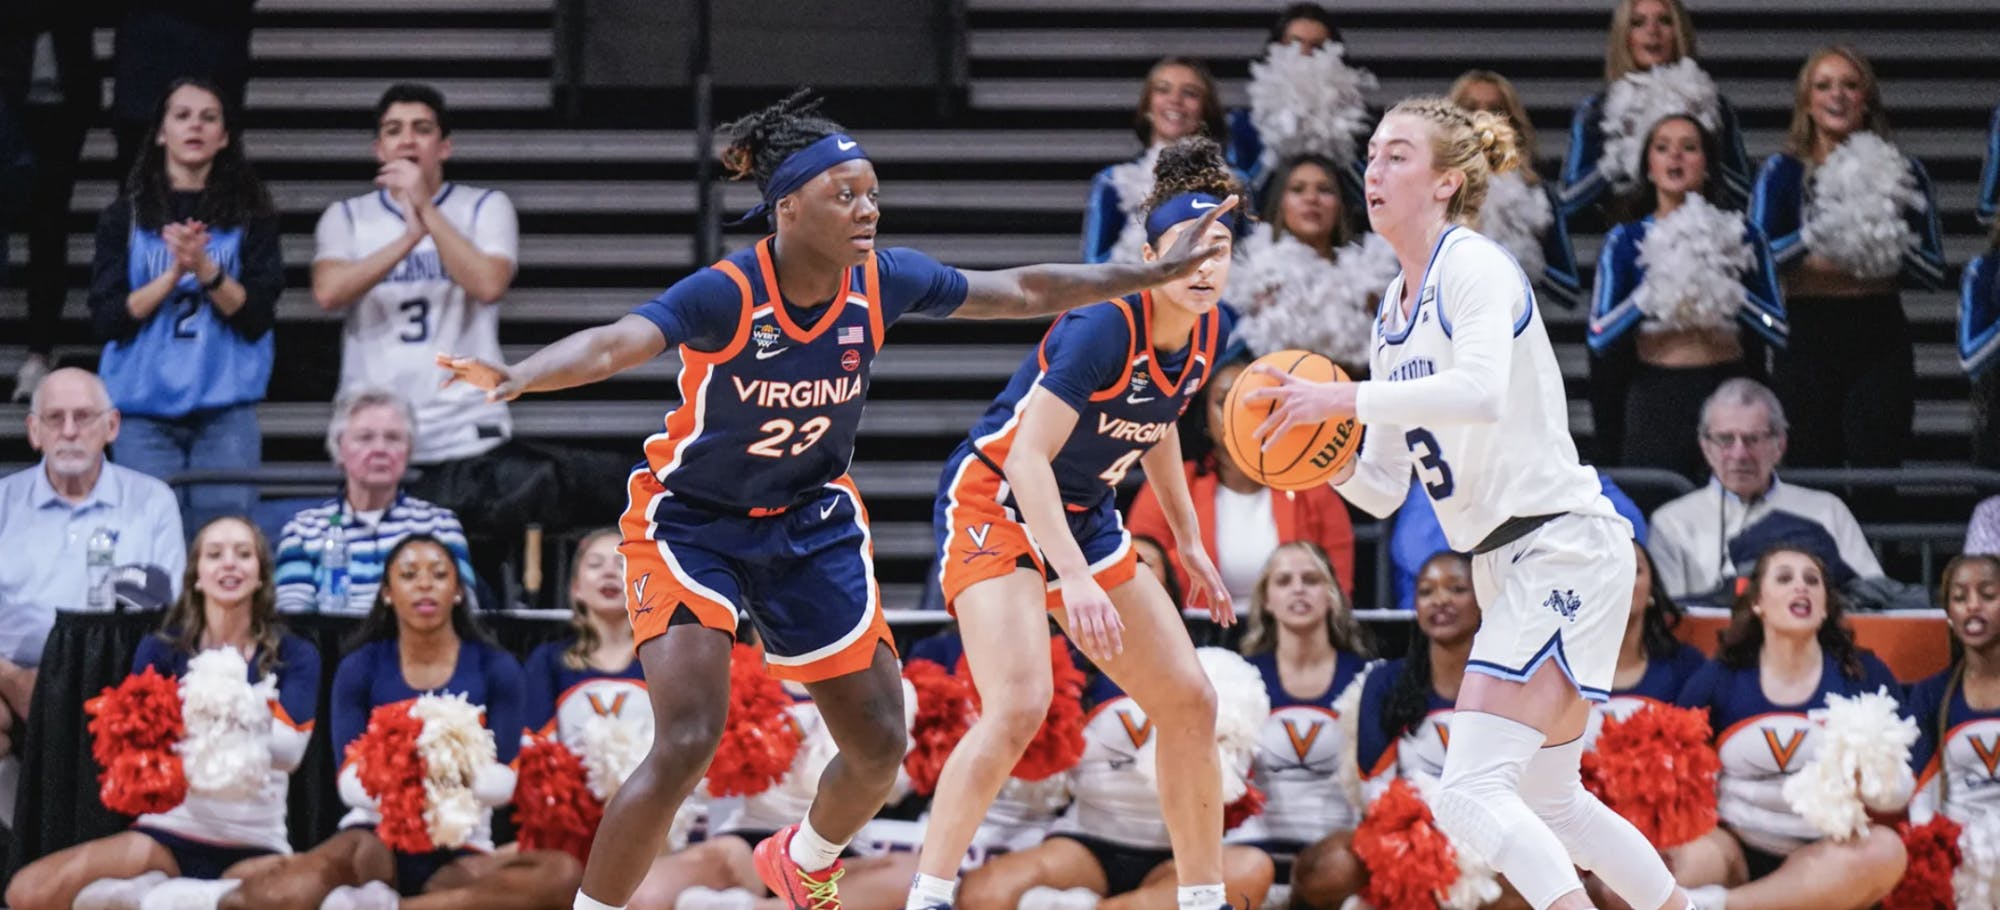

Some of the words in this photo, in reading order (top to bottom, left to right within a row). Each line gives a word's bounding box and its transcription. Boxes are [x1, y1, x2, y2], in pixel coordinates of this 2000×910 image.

[174, 291, 200, 339] 2
[400, 297, 430, 343] 3
[732, 373, 861, 408] VIRGINIA
[746, 415, 832, 458] 23
[1098, 449, 1144, 486] 4
[1405, 426, 1455, 501] 3
[965, 522, 994, 550] V
[633, 573, 650, 606] V
[1281, 718, 1325, 761] V
[1761, 727, 1808, 772] V
